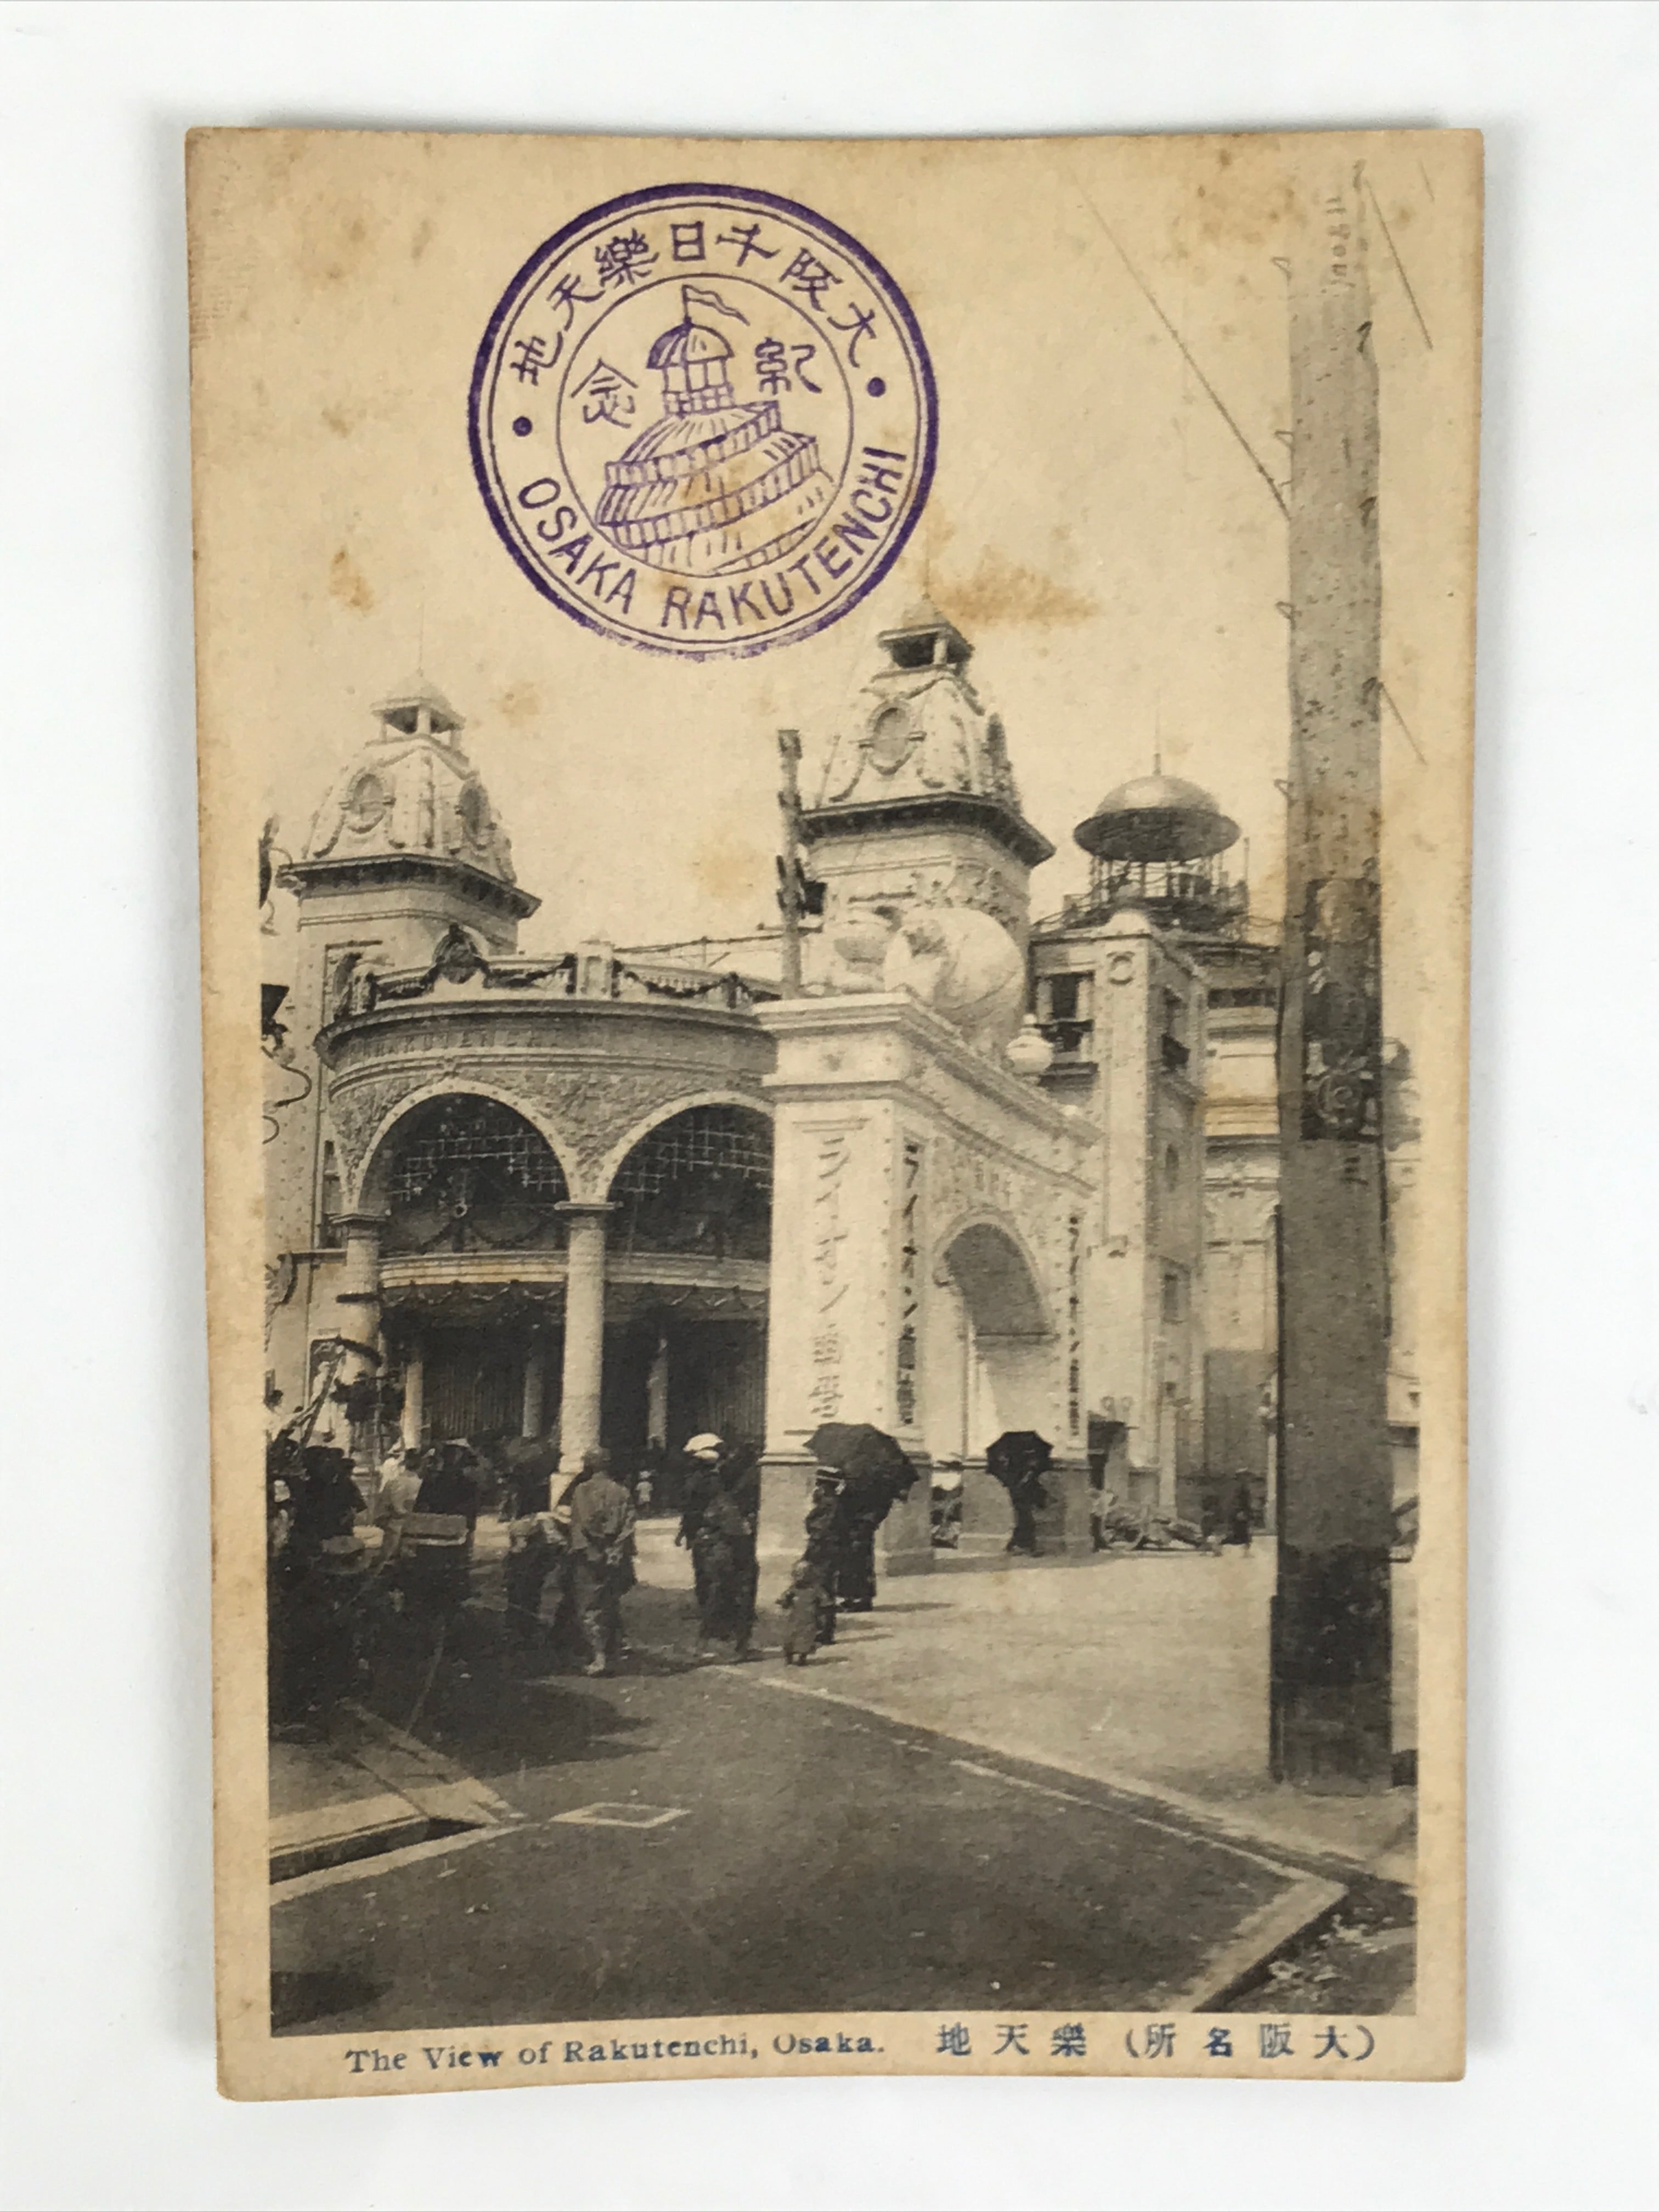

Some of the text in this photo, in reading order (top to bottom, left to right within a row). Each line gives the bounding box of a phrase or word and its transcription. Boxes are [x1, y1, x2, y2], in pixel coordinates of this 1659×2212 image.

[518, 446, 907, 631] OSAKA RAKUTENCHI
[344, 2031, 885, 2074] The View of Rakutenchi, Osaka.
